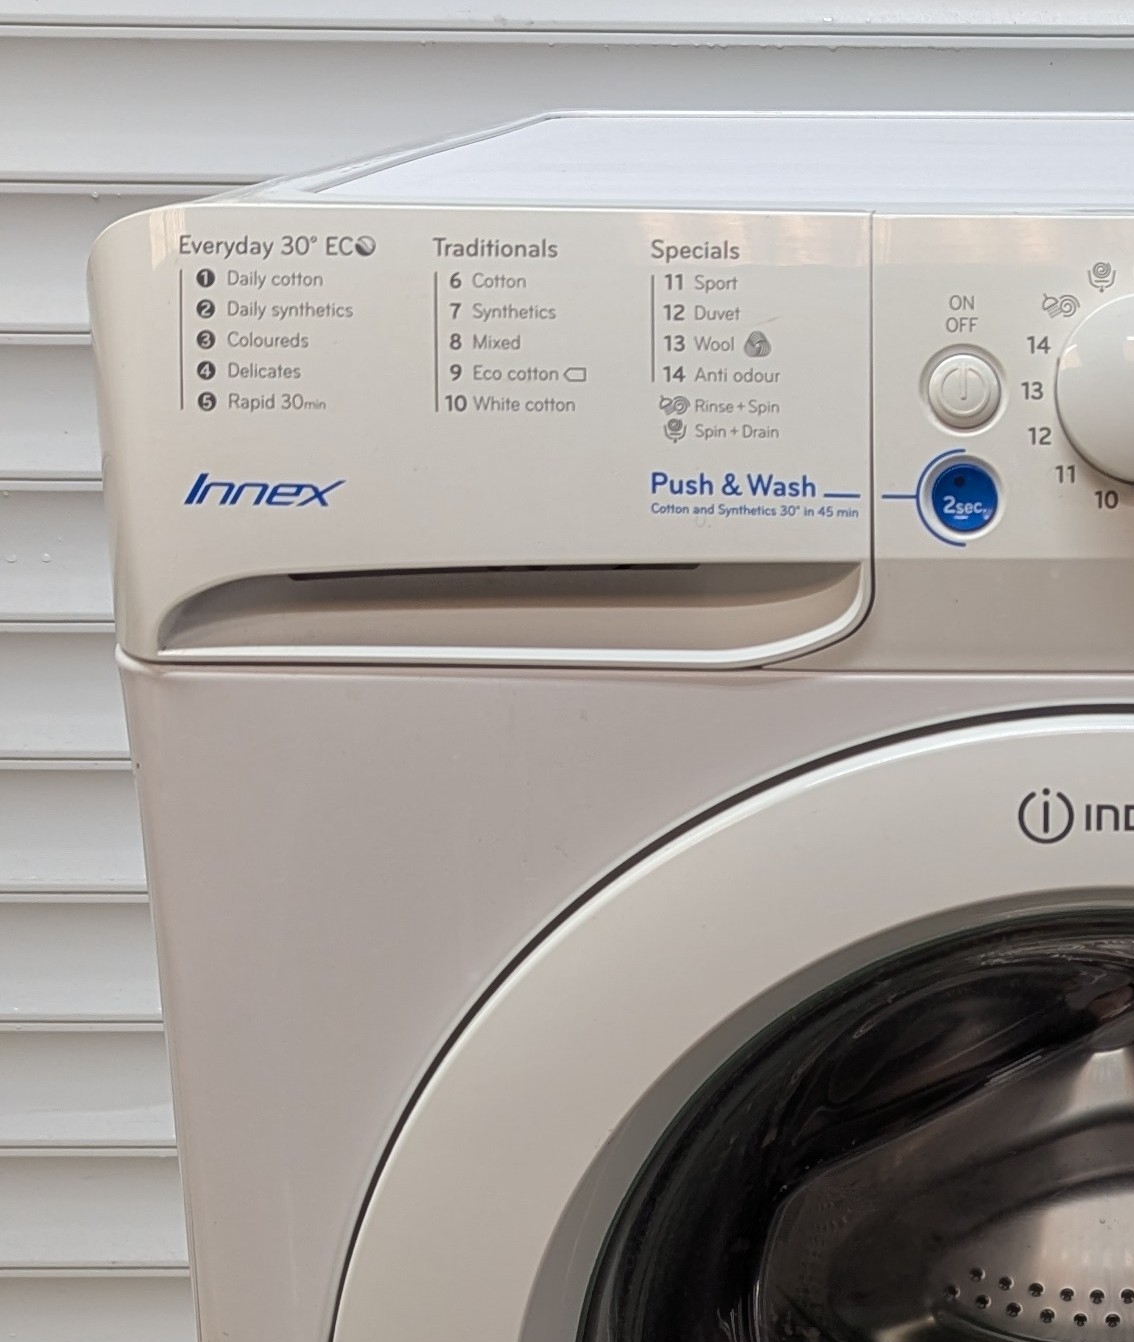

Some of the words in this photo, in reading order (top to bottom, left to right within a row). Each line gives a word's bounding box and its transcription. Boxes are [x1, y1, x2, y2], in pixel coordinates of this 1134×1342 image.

[179, 235, 274, 259] Everyday
[280, 236, 318, 256] 30°
[432, 237, 558, 259] Traditionals
[651, 240, 740, 262] Specials
[227, 271, 266, 289] Daily
[271, 273, 323, 288] cotton
[450, 272, 462, 289] 6
[472, 272, 527, 288] Cotton
[664, 274, 684, 291] 11
[694, 275, 738, 293] Sport
[227, 301, 266, 320] Daily
[271, 302, 353, 320] synthetics
[450, 303, 462, 320] 7
[472, 303, 557, 322] Synthetics
[663, 304, 686, 321] 12
[694, 305, 741, 321] Duvet
[949, 296, 975, 311] ON
[946, 317, 978, 333] OFF
[227, 331, 309, 349] Coloureds
[450, 333, 462, 350] 8
[472, 334, 521, 350] Mixed
[663, 335, 686, 352] 13
[694, 336, 735, 352] Wool
[1028, 336, 1051, 354] 14
[228, 362, 301, 380] Delicates
[450, 364, 462, 382] 9
[473, 365, 502, 381] Eco
[508, 366, 559, 382] cotton
[663, 366, 686, 383] 14
[694, 368, 728, 384] Anti
[734, 369, 781, 384] odour
[1022, 382, 1044, 400] 13
[228, 394, 275, 413] Rapid
[444, 394, 468, 412] 10
[473, 395, 520, 412] White
[525, 398, 576, 412] cotton
[695, 399, 734, 414] Rinse
[737, 402, 746, 412] +
[748, 399, 780, 416] Spin
[695, 425, 726, 441] Spin
[730, 428, 739, 436] +
[742, 425, 779, 440] Drain
[1028, 428, 1052, 446] 12
[1055, 466, 1076, 484] 11
[183, 473, 346, 506] Innex
[651, 472, 713, 495] Push
[722, 473, 743, 496] &
[747, 474, 816, 497] Wash
[1094, 490, 1118, 510] 10
[651, 502, 689, 515] Cotton
[693, 504, 715, 516] and
[718, 504, 776, 518] Synthetics
[804, 506, 815, 517] in
[818, 506, 834, 518] 45
[836, 507, 859, 518] min
